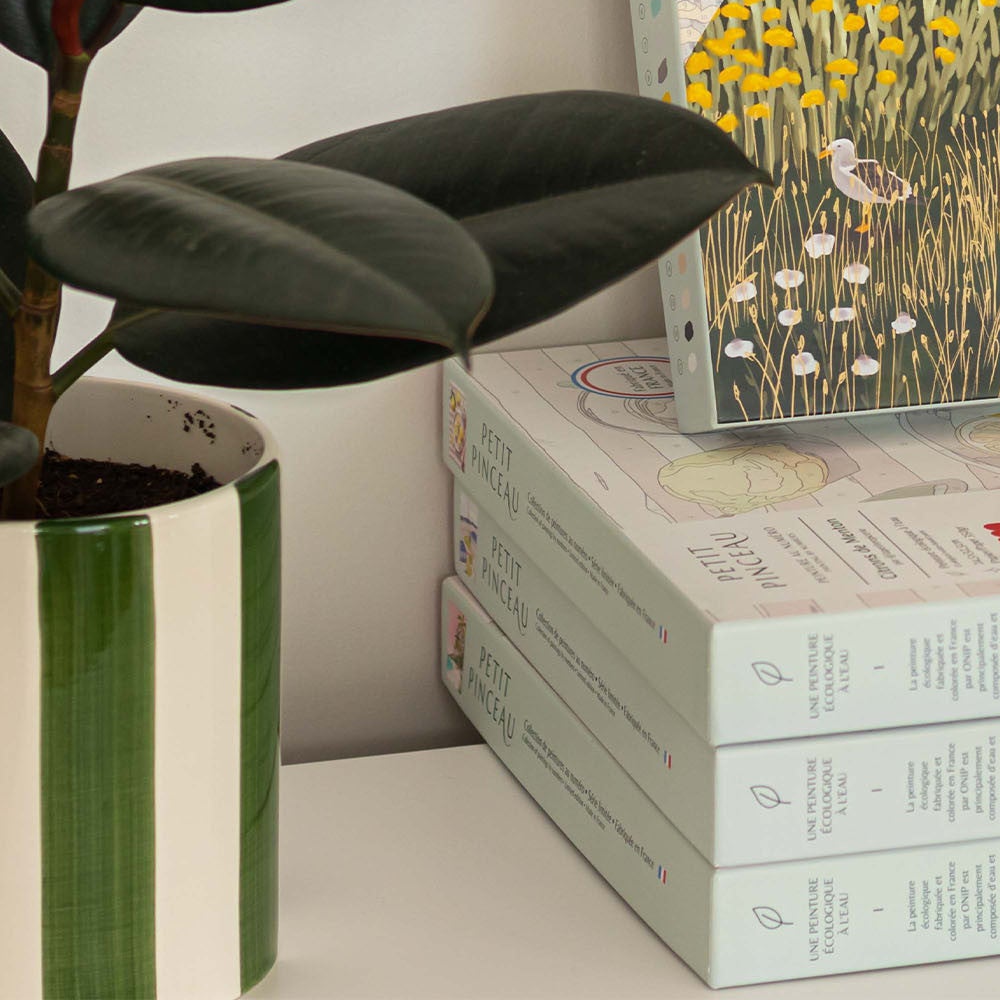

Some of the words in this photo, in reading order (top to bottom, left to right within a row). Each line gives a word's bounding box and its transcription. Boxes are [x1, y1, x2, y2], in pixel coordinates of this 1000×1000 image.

[481, 422, 513, 472] PETIT
[471, 445, 520, 521] PINCEAU
[827, 518, 857, 544] Menton
[492, 536, 522, 587] PETIT
[687, 546, 743, 583] PETIT
[710, 531, 787, 589] PINCEAU
[863, 554, 898, 580] Citrons
[482, 556, 529, 637] PINCEAU
[479, 646, 512, 698] PETIT
[808, 634, 818, 691] PEINTURE
[823, 634, 835, 712] ÉCOLOGIQUE
[839, 650, 849, 682] L'EAU
[467, 666, 517, 747] PINCEAU
[810, 695, 820, 719] UNE
[988, 736, 995, 745] et
[933, 757, 941, 766] et
[946, 743, 955, 773] France
[987, 748, 996, 772] d'eau
[806, 758, 817, 813] PEINTURE
[821, 758, 833, 834] ÉCOLOGIQUE
[837, 773, 847, 804] L'EAU
[906, 761, 916, 799] peinture
[919, 761, 930, 810] écologique
[933, 769, 943, 811] fabriquée
[948, 776, 955, 786] en
[960, 768, 969, 793] ONIP
[906, 802, 915, 813] La
[947, 789, 955, 822] colorée
[961, 797, 970, 811] par
[988, 775, 998, 821] composée
[807, 817, 817, 841] UNE
[988, 855, 996, 863] et
[934, 876, 942, 885] et
[947, 861, 956, 891] France
[988, 866, 996, 890] d'eau
[808, 878, 818, 934] PEINTURE
[839, 893, 849, 924] L'EAU
[907, 881, 918, 918] peinture
[920, 880, 931, 929] écologique
[934, 888, 944, 930] fabriquée
[949, 895, 956, 905] en
[961, 887, 970, 912] ONIP
[974, 865, 985, 932] principalement
[823, 878, 835, 954] ÉCOLOGIQUE
[908, 921, 917, 932] La
[948, 908, 957, 941] colorée
[962, 916, 972, 929] par
[988, 894, 999, 939] composée
[809, 938, 819, 961] UNE
